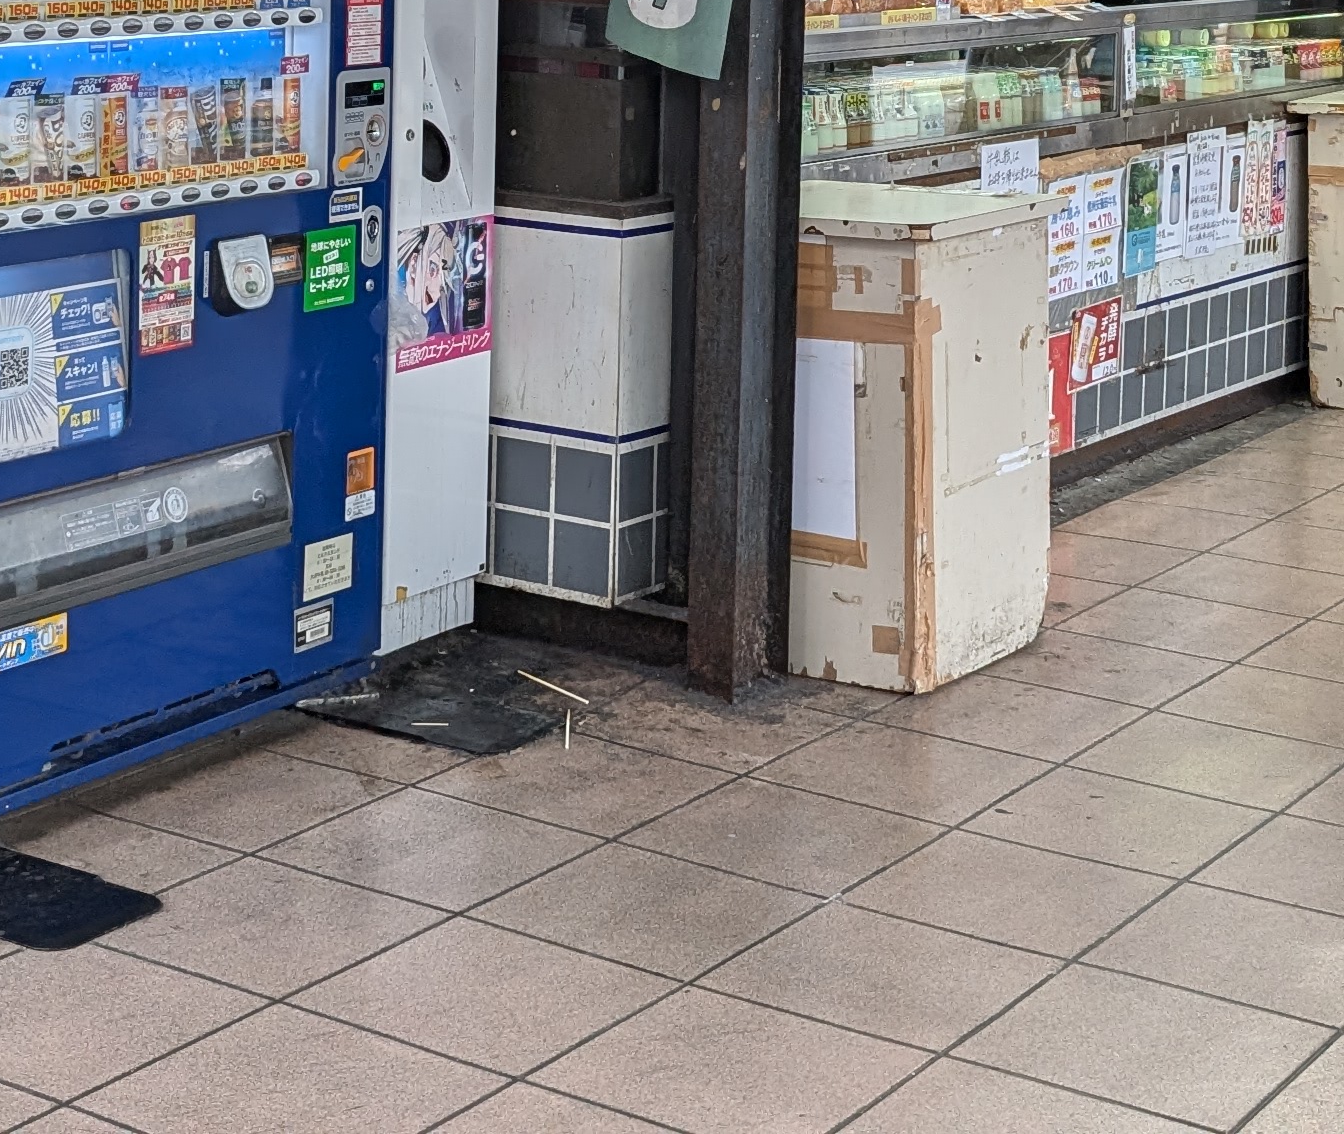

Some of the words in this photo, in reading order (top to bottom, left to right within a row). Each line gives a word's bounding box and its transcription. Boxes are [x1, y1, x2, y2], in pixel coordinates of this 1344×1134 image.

[309, 275, 351, 293] ヒートポンプ
[60, 305, 91, 320] チェック!
[398, 329, 490, 370] 無敵のエナジードリンク
[65, 362, 98, 378] スキャン!
